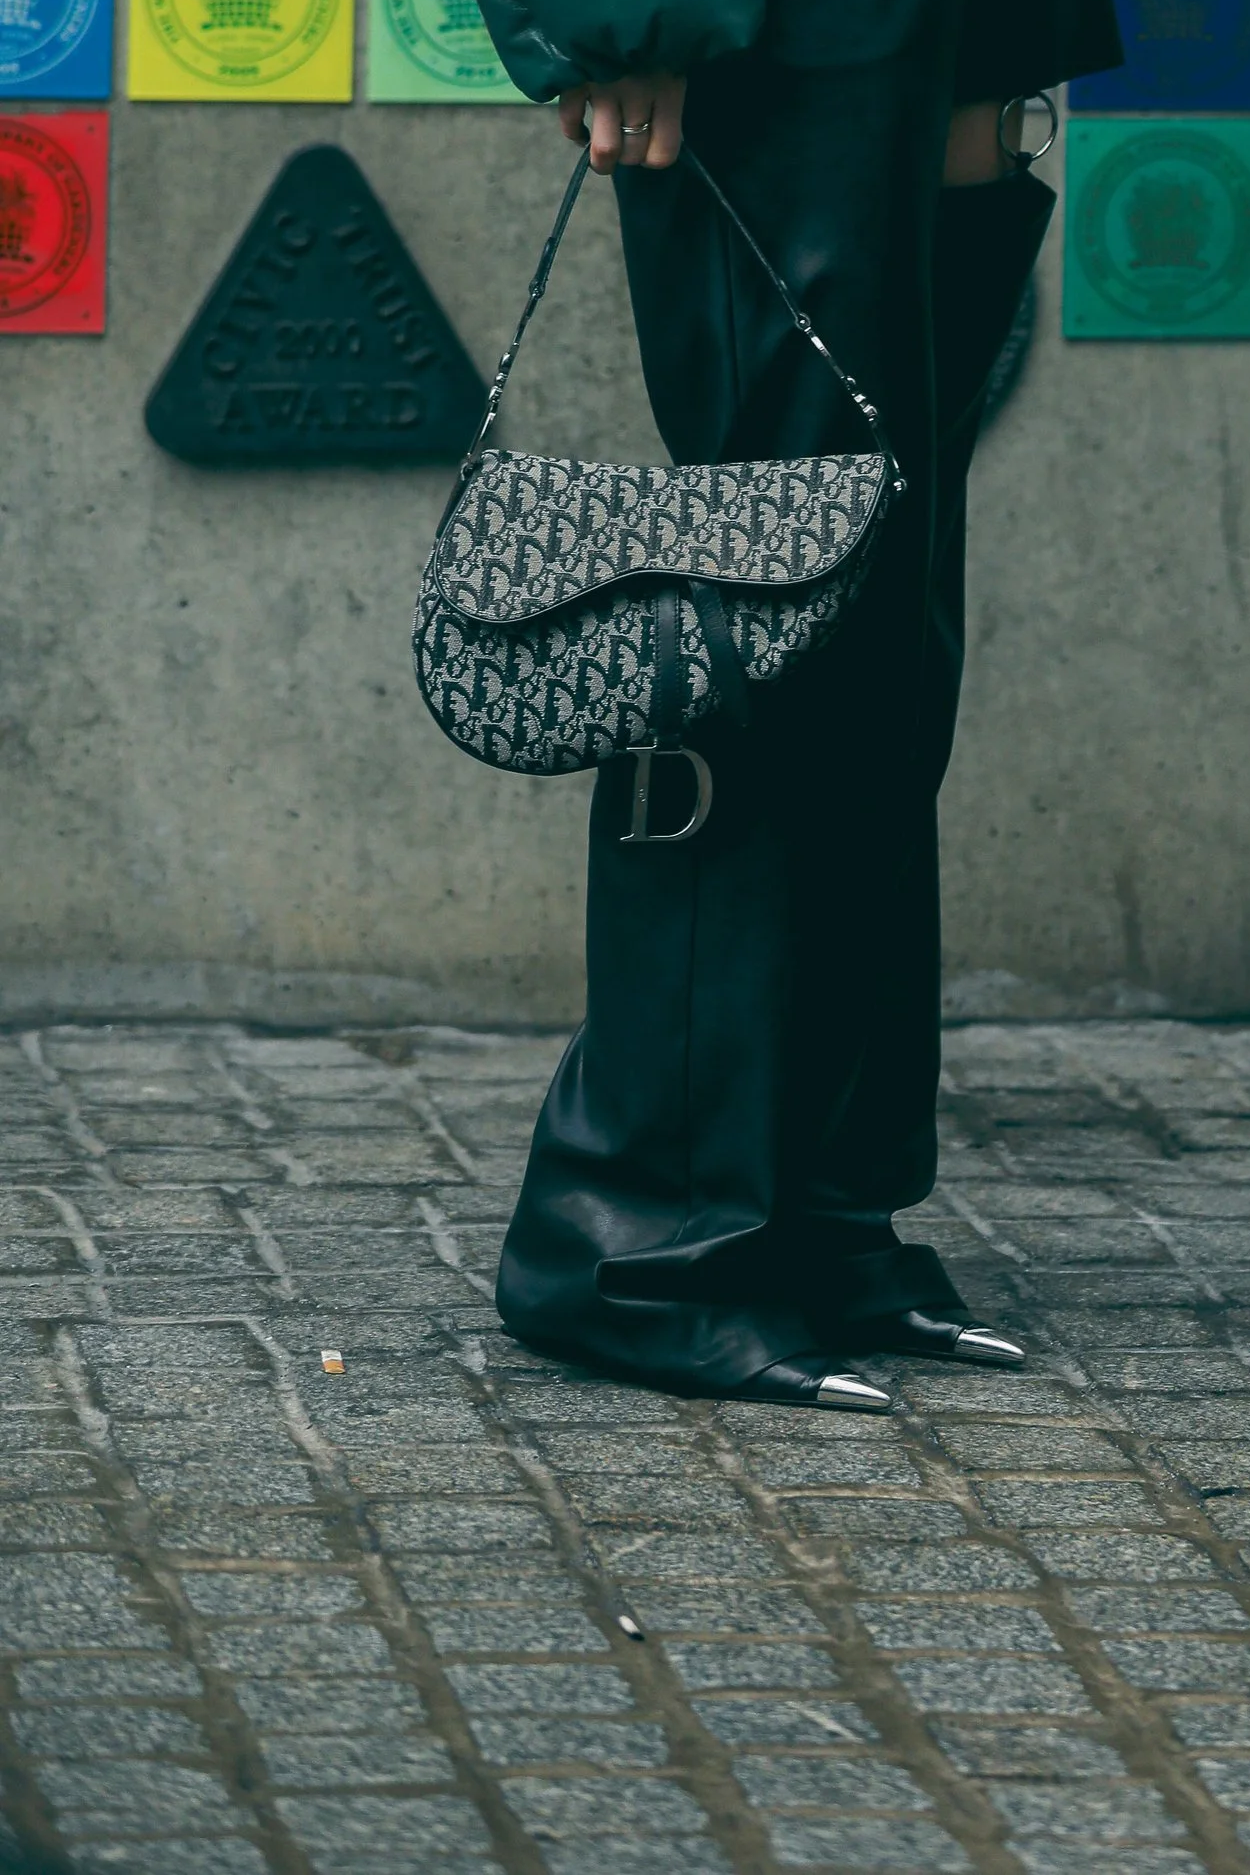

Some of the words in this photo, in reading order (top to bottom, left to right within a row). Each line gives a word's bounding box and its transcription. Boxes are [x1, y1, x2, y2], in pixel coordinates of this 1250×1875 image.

[202, 209, 318, 379] CIVIC
[329, 205, 440, 370] TRUST
[213, 380, 426, 434] AWARD
